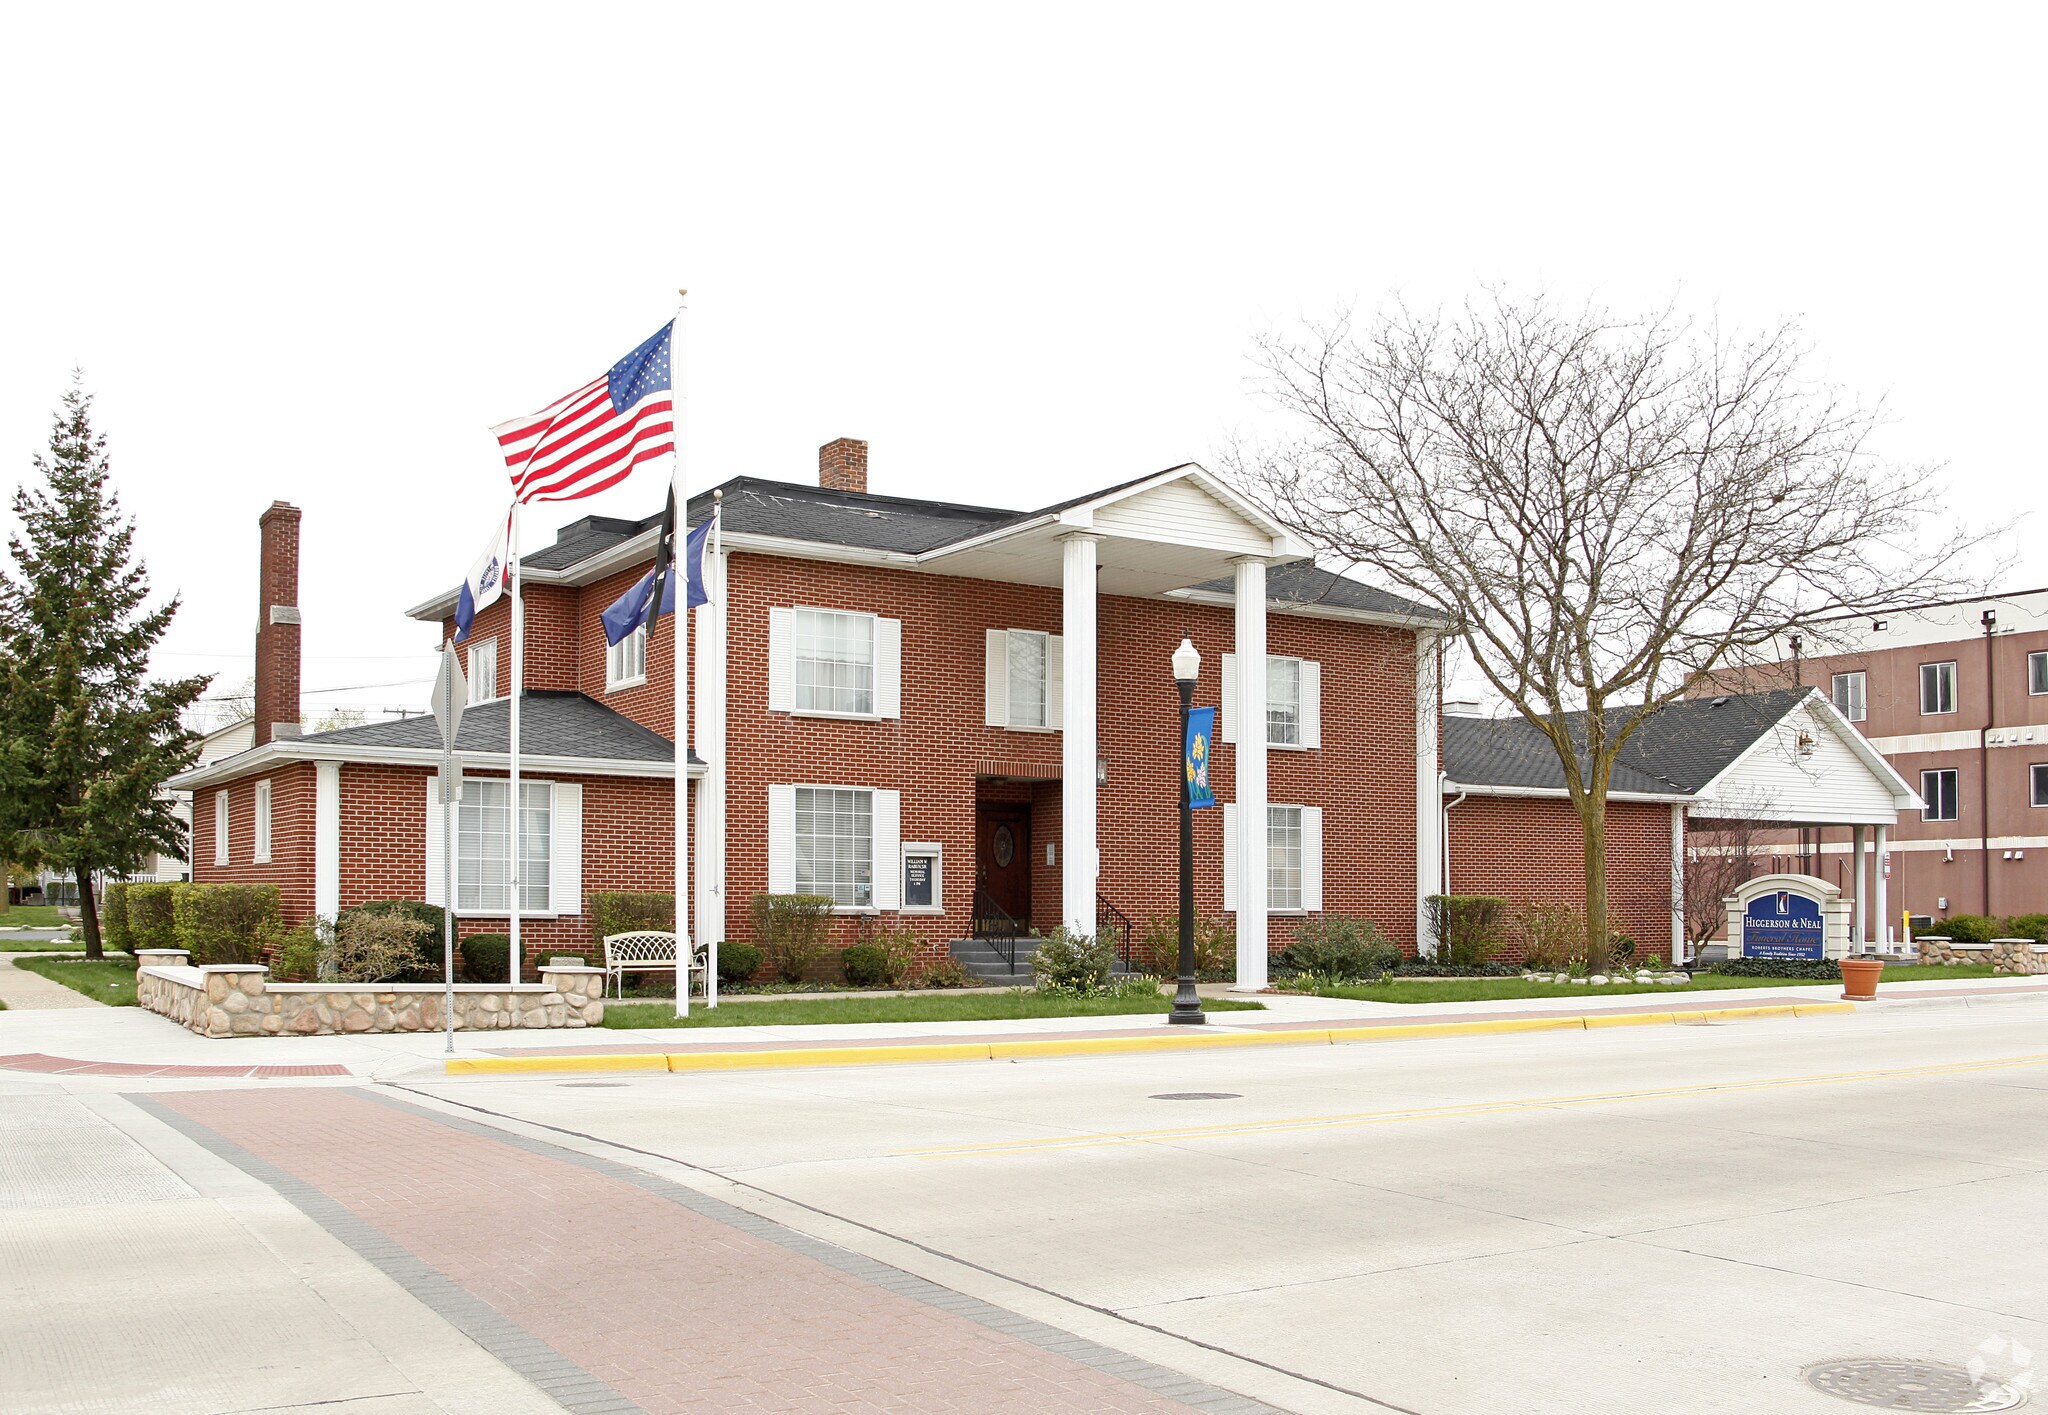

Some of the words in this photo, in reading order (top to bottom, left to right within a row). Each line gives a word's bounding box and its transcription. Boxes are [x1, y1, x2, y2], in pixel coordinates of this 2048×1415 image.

[1746, 916, 1790, 928] HIGGERSON
[1792, 919, 1798, 928] &
[1800, 918, 1821, 928] NEAL
[1748, 931, 1786, 942] Funeral
[1787, 932, 1819, 943] Home
